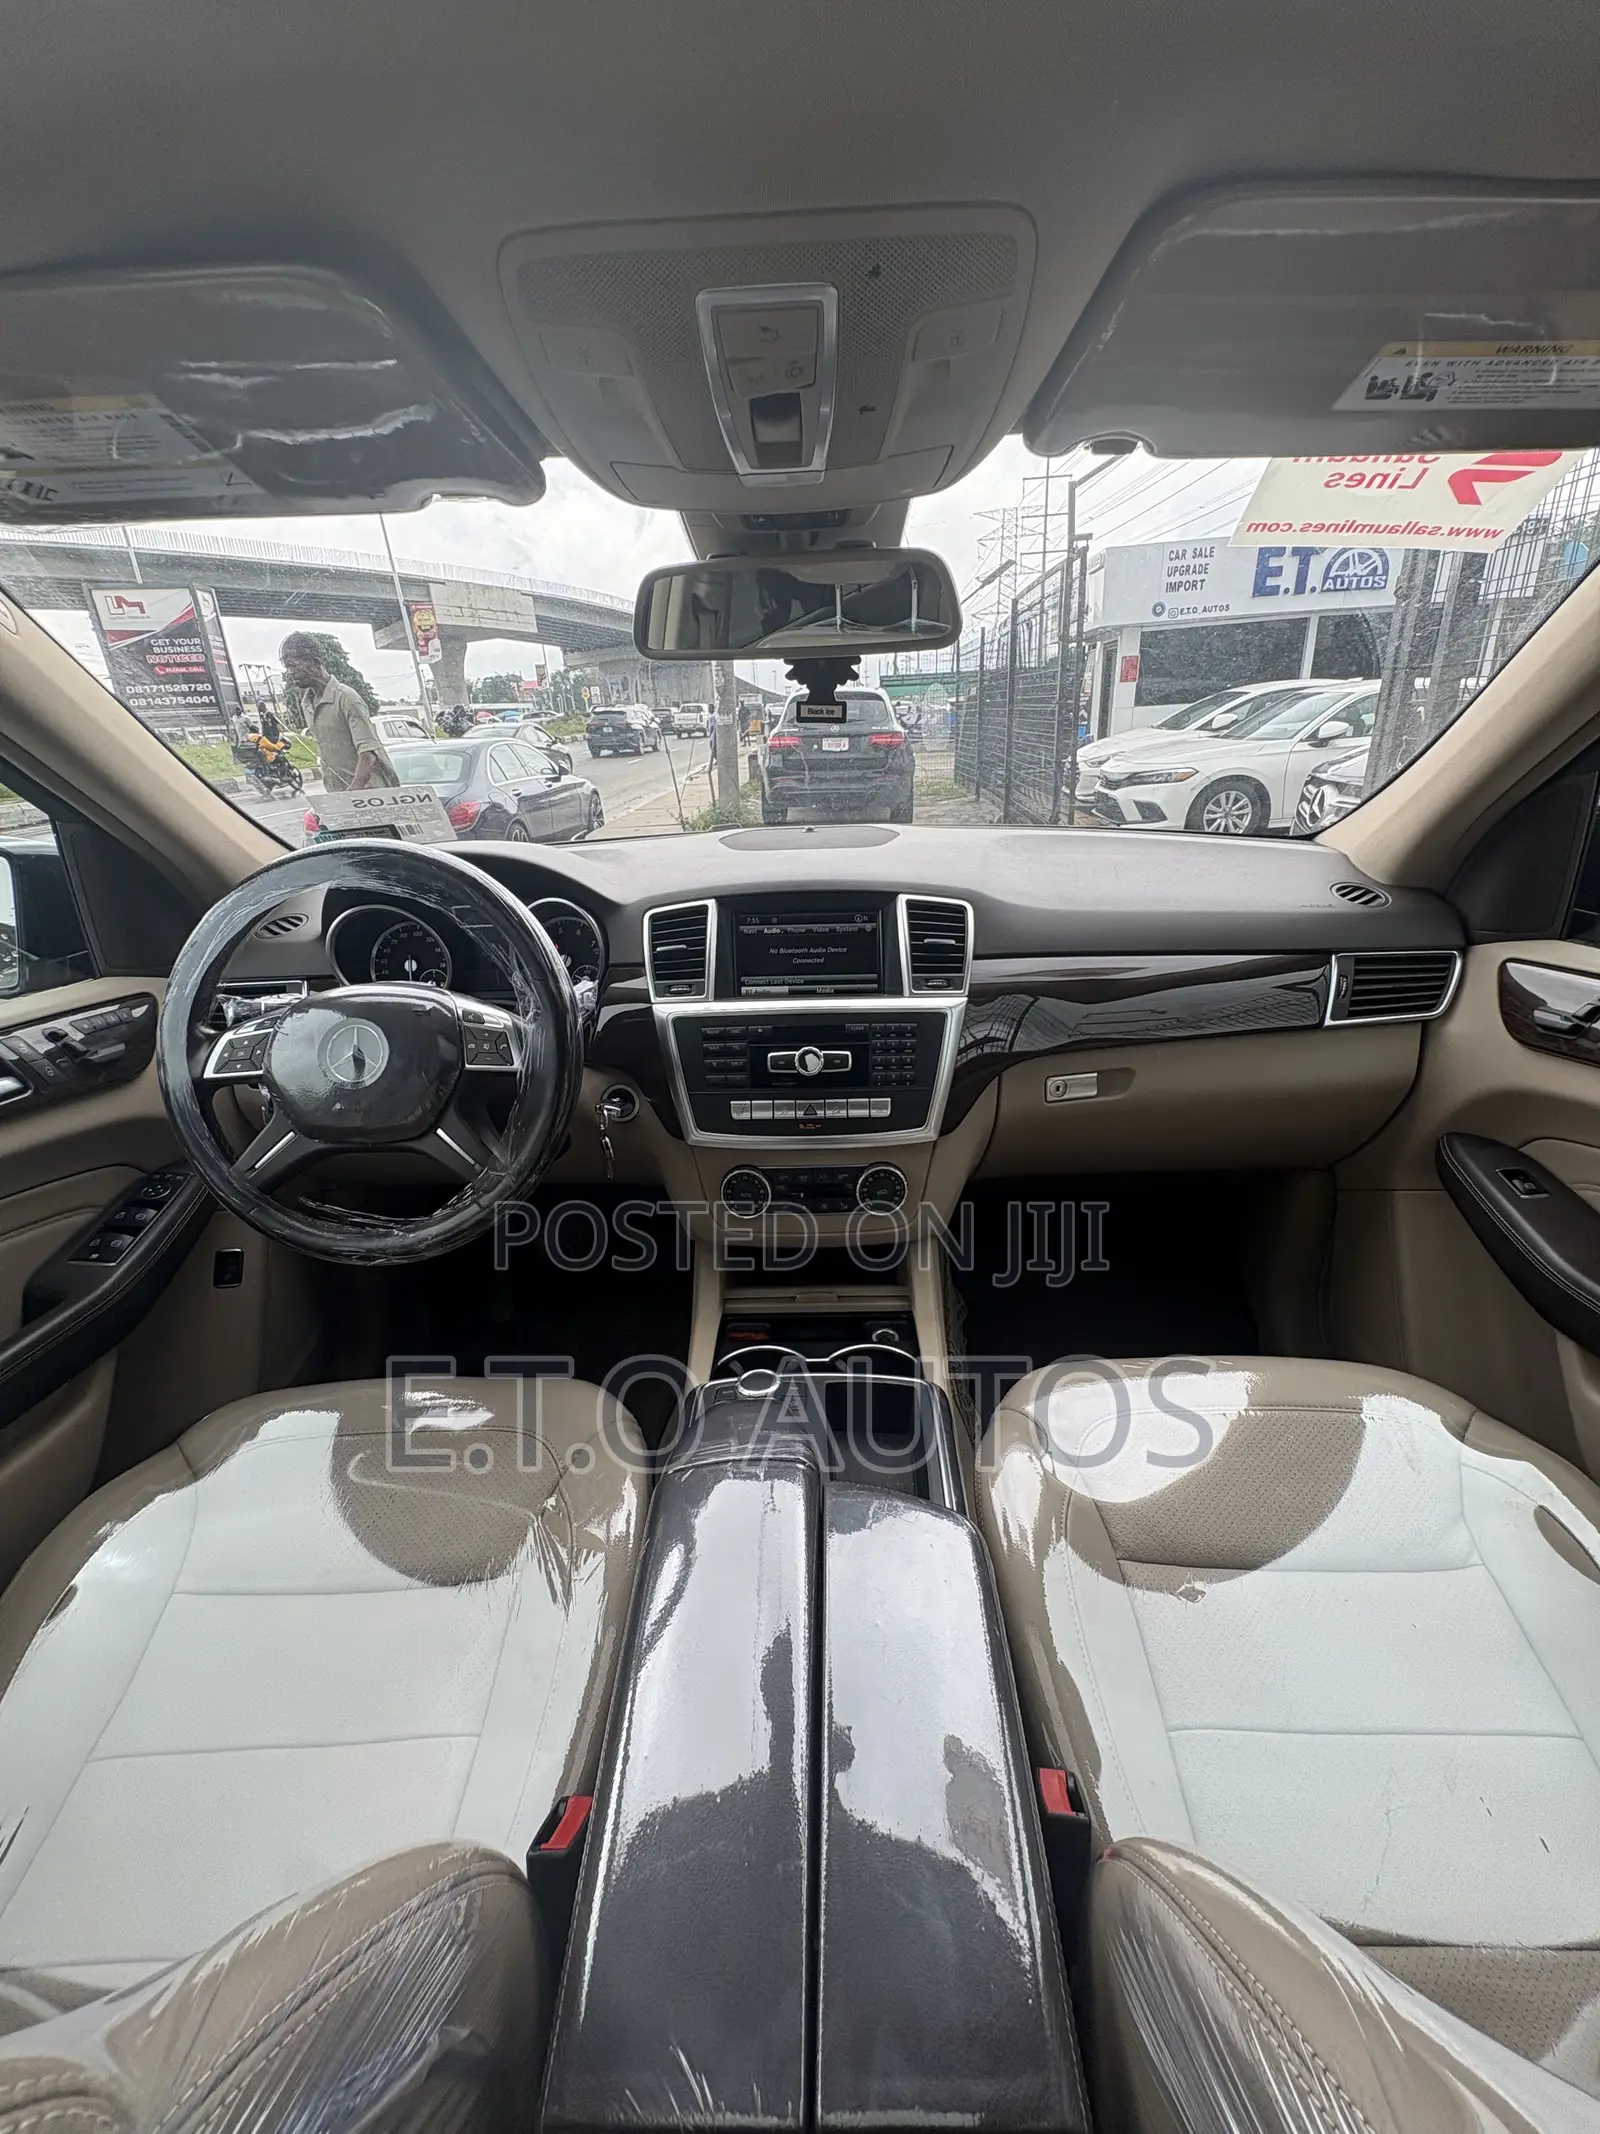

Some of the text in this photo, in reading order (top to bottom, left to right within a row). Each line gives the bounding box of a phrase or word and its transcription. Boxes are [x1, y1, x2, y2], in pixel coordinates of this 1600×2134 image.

[1496, 344, 1574, 355] WARNING
[1168, 546, 1215, 562] CAR SALE
[1166, 563, 1210, 578] UPGRADE
[1165, 579, 1206, 594] IMPORT
[1322, 575, 1387, 591] AUTOS
[173, 638, 202, 646] YOUR
[152, 646, 203, 654] BUSINESS
[146, 654, 206, 664] NOTICED
[125, 684, 212, 694] 08171528720
[807, 707, 824, 715] Black
[836, 926, 858, 934] System
